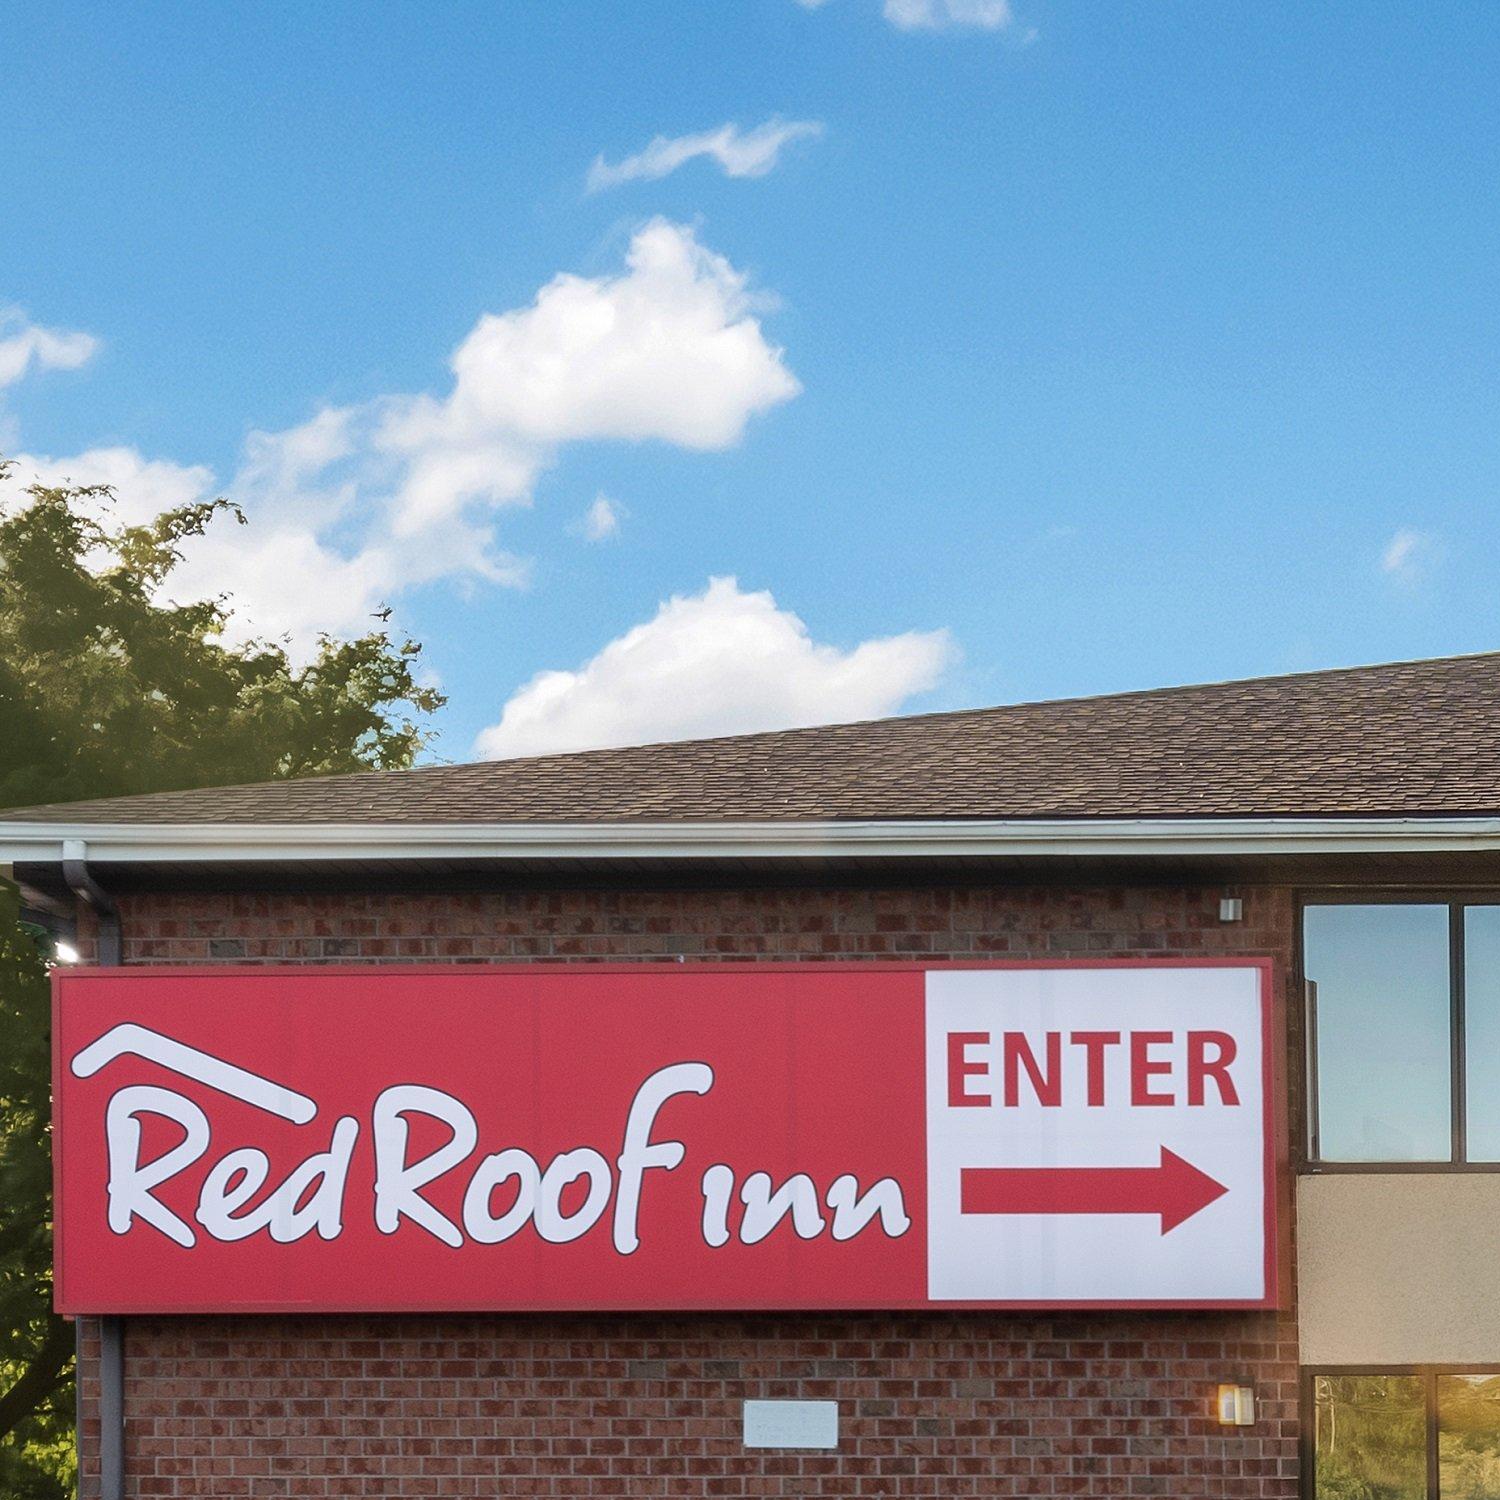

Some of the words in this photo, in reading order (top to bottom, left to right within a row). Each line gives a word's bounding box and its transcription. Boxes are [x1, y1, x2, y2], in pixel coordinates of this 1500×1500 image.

[946, 1030, 1241, 1108] ENTER
[105, 1083, 360, 1249] Red
[372, 1061, 715, 1256] Roof
